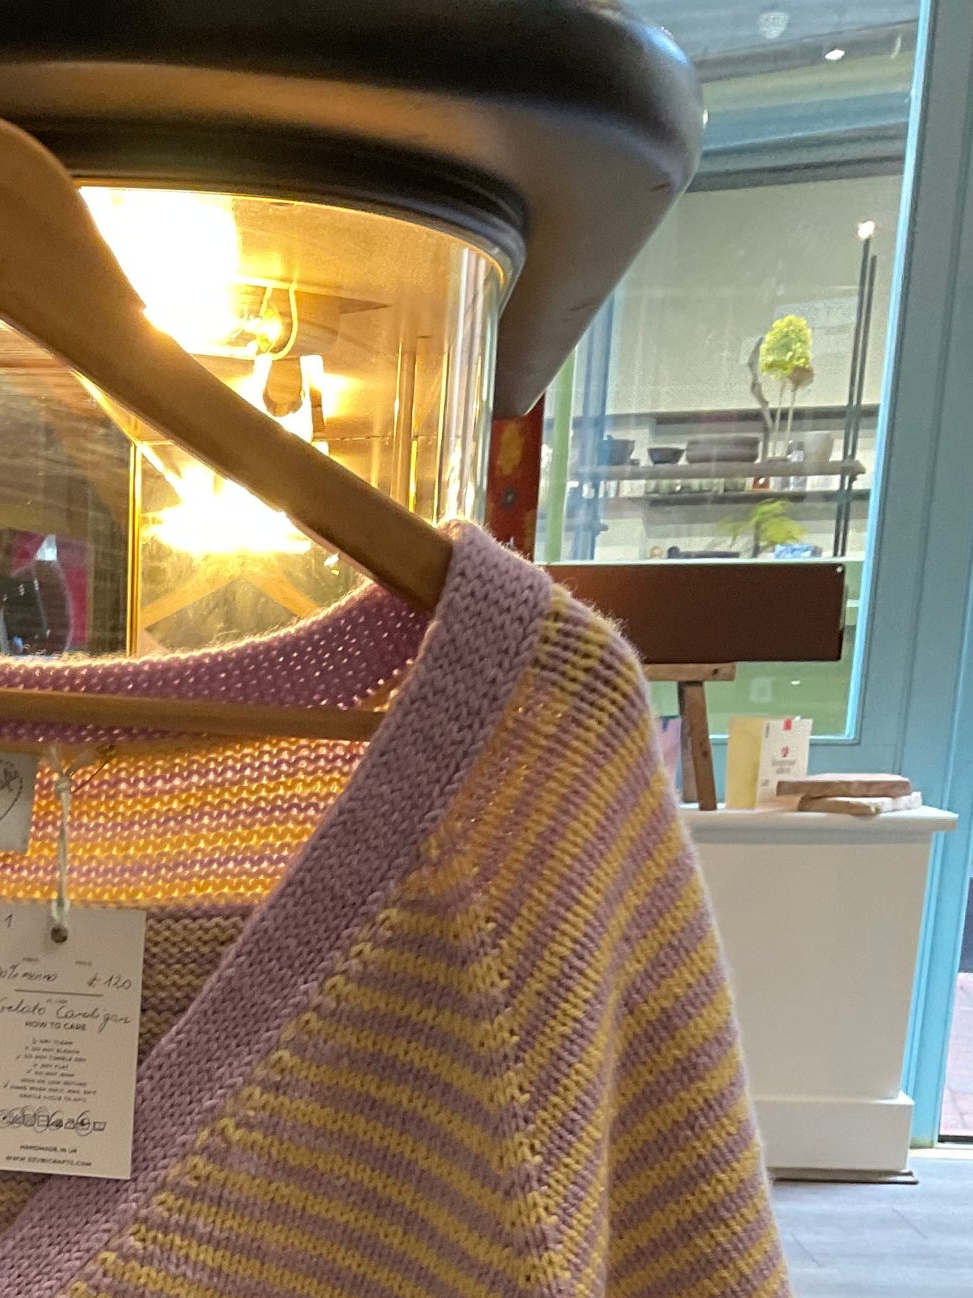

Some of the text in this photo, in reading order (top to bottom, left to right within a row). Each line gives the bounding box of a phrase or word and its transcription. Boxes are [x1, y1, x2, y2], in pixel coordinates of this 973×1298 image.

[25, 1020, 87, 1031] HOW TO CARE
